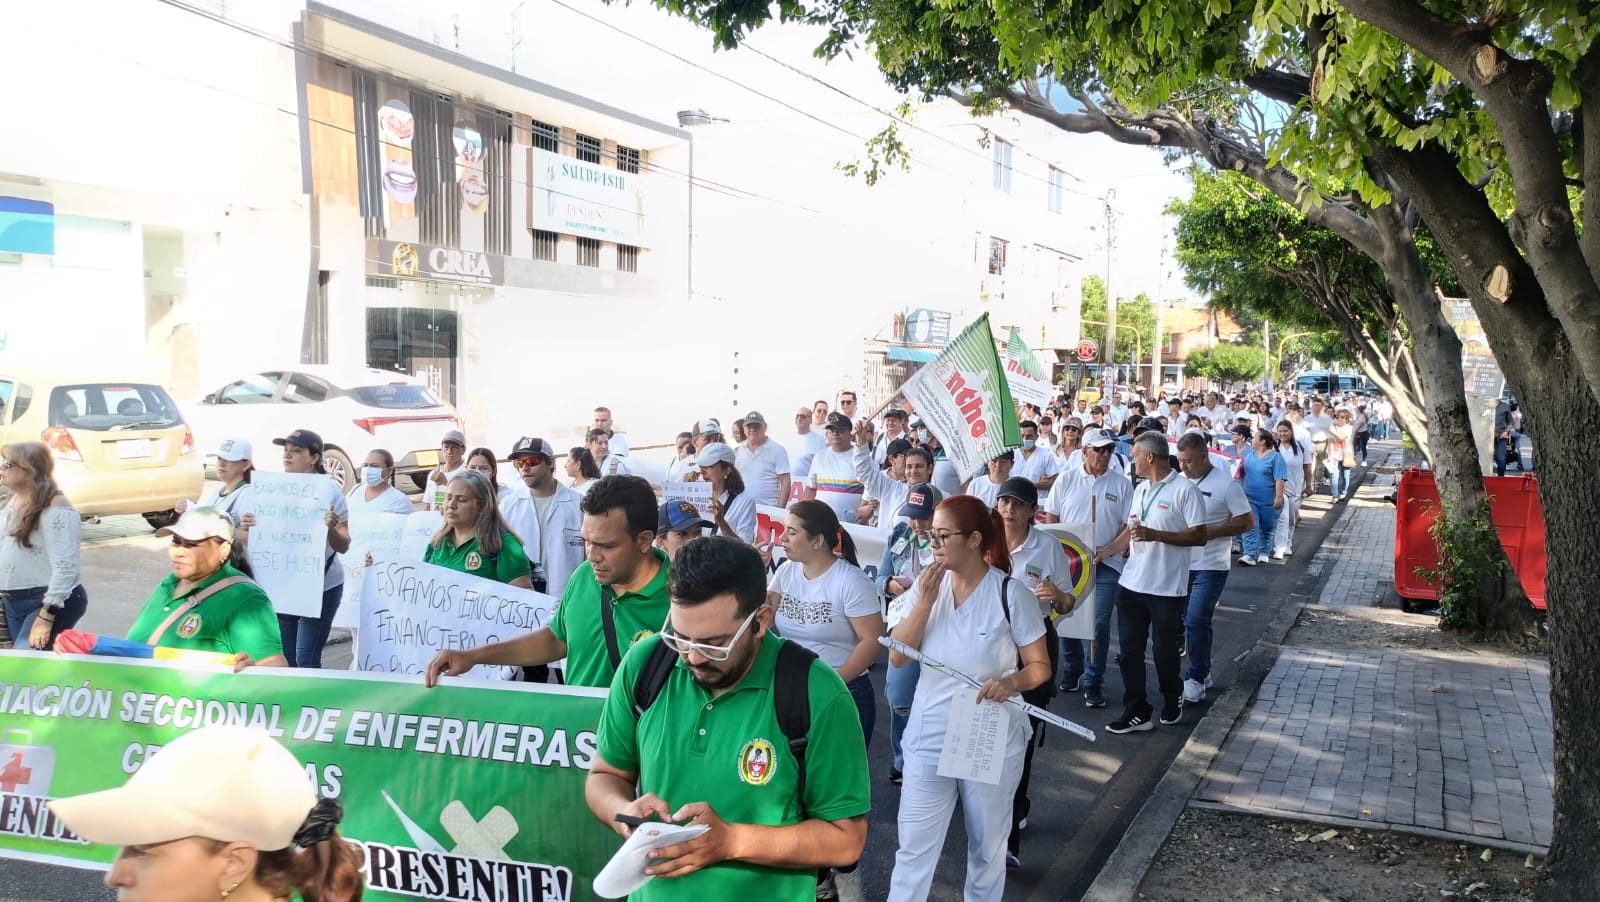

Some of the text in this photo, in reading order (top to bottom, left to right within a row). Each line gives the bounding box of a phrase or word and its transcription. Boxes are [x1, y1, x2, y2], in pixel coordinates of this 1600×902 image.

[429, 247, 492, 277] CREA
[272, 530, 313, 544] NUESTRA
[251, 550, 280, 572] ESE
[374, 561, 459, 613] ESTAMOS
[0, 680, 597, 770] IACIÓN SECCIONAL DE ENFERMERAS
[357, 843, 570, 902] RESENTE!
